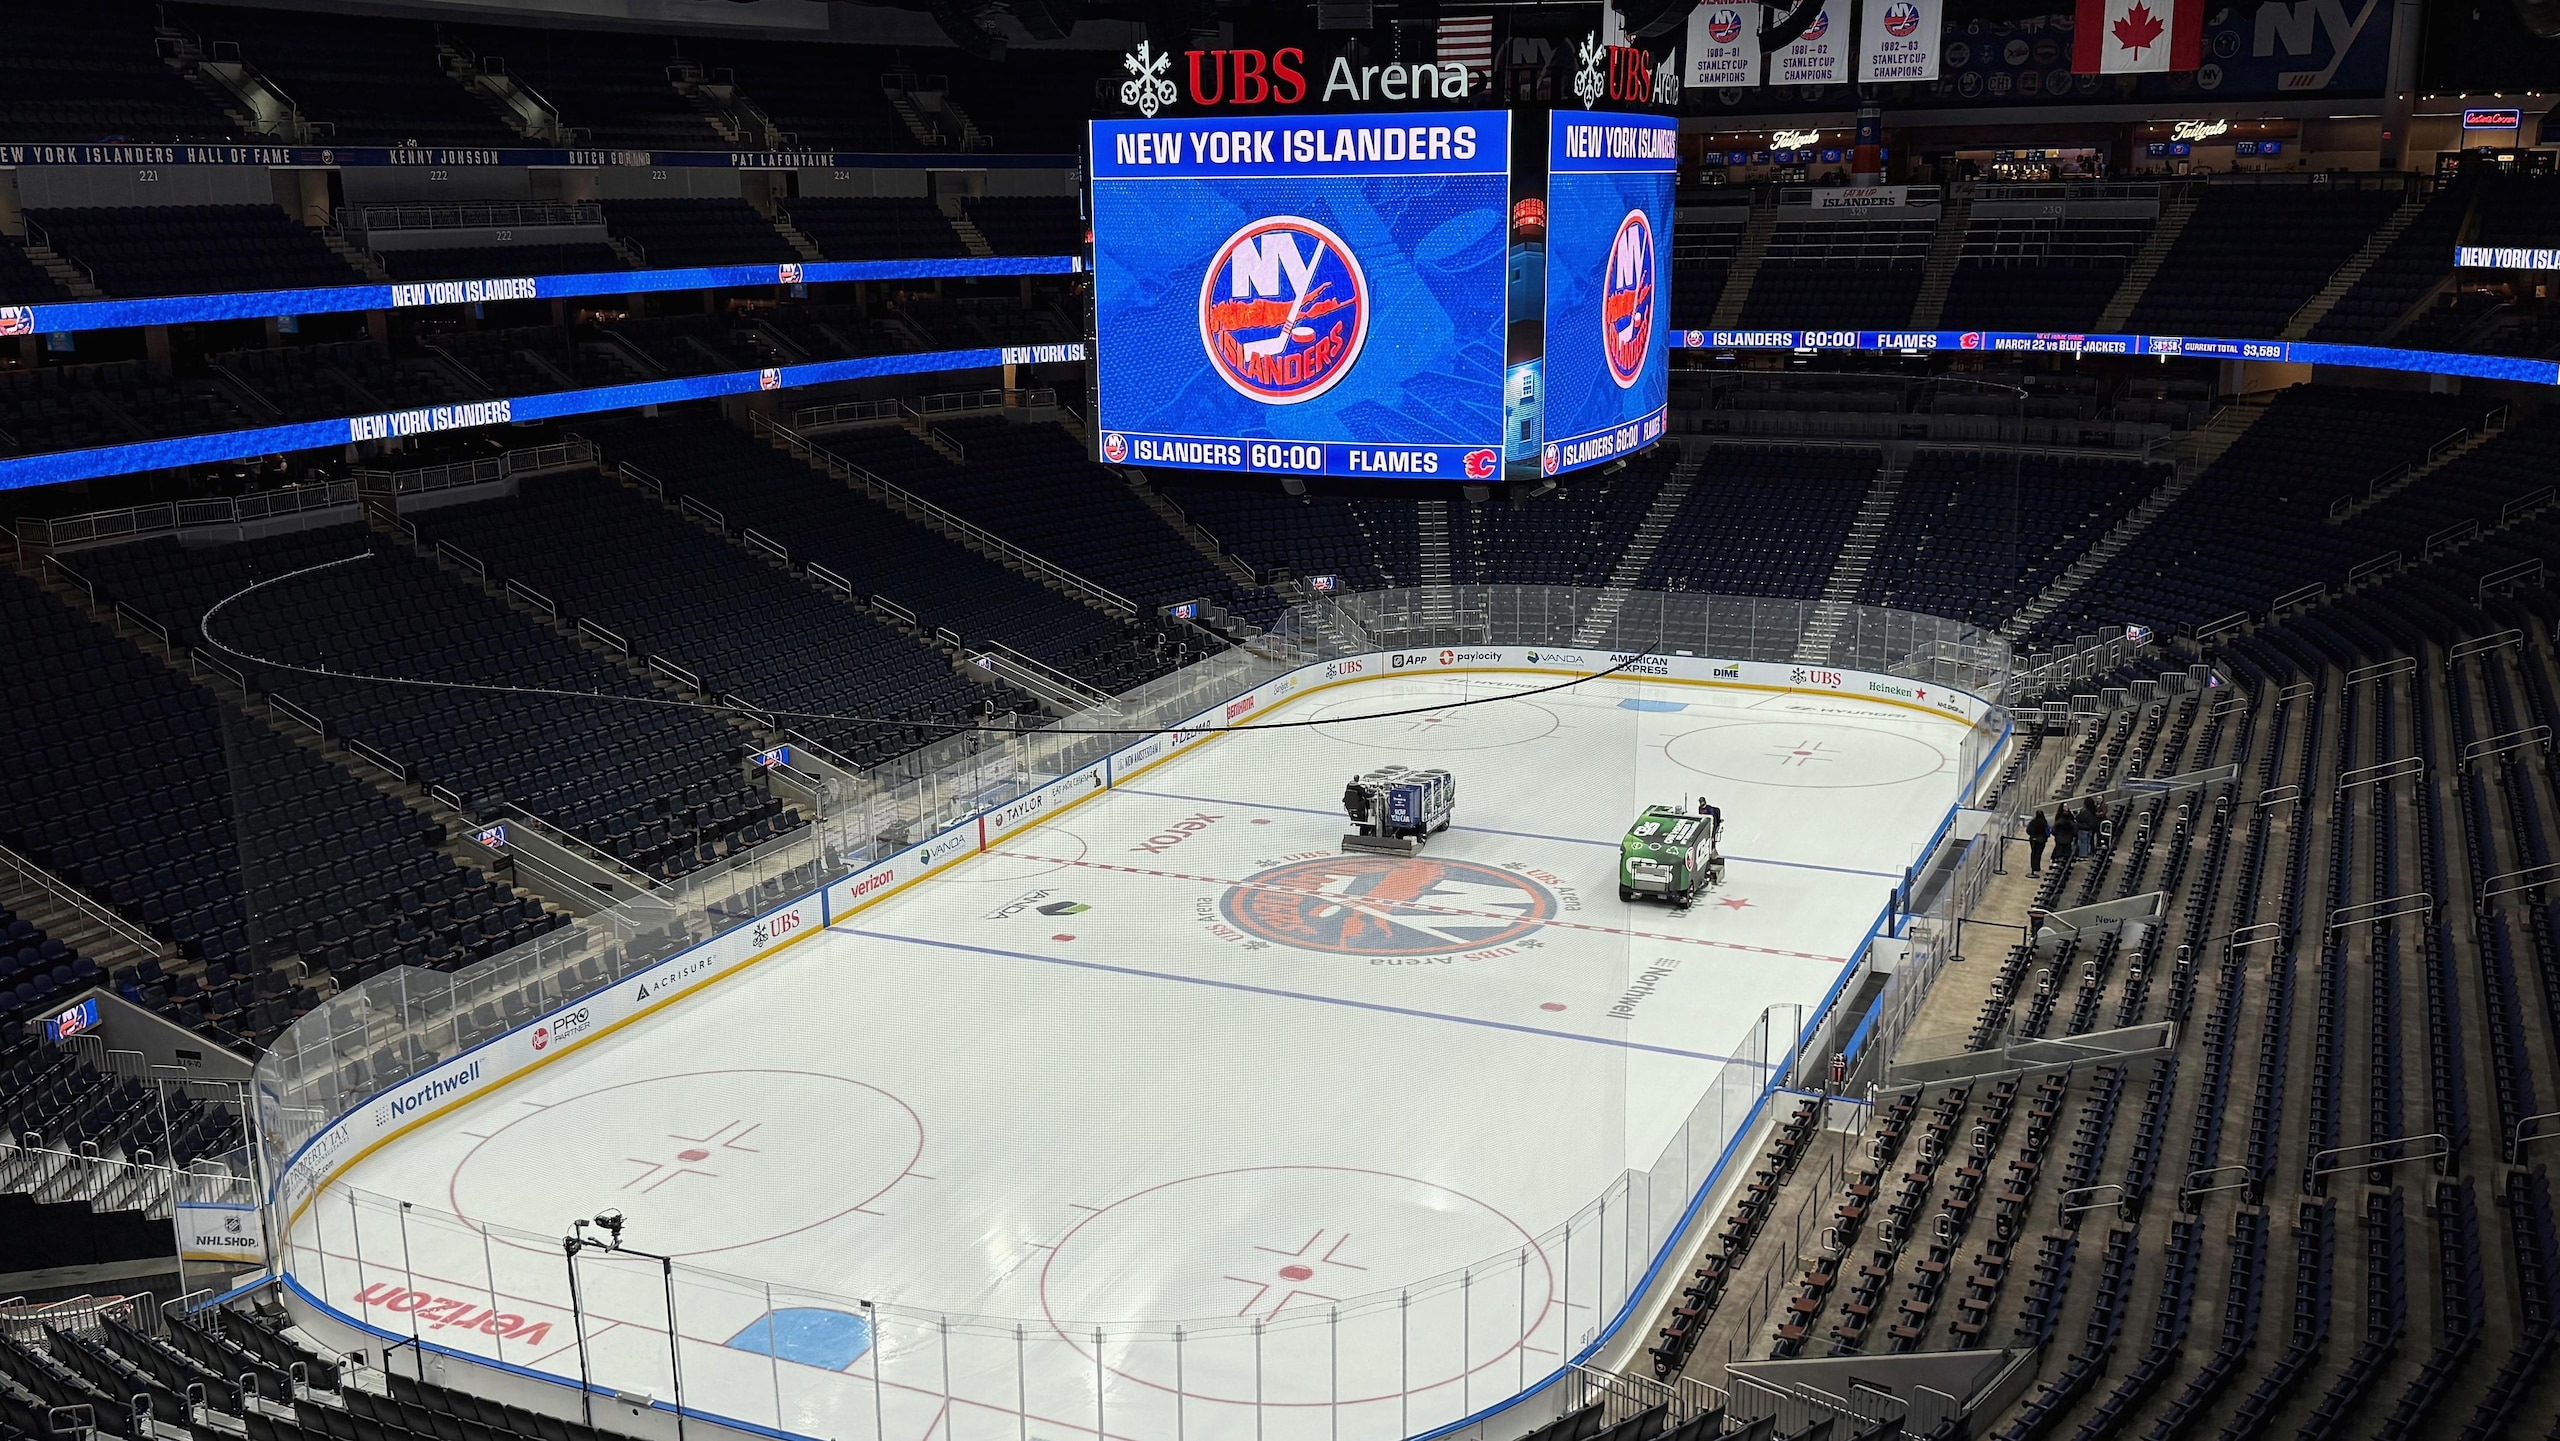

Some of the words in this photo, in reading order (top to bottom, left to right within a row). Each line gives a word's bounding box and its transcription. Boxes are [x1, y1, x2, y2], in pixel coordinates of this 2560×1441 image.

[1697, 60, 1731, 70] STANLEY
[1732, 60, 1748, 70] CUP
[1783, 57, 1817, 68] STANLEY
[1818, 57, 1835, 68] CUP
[1872, 54, 1907, 65] STANLEY
[1908, 53, 1926, 64] CUP
[1185, 48, 1307, 105] UBS
[1322, 57, 1470, 102] Arena
[1608, 45, 1651, 103] UBS
[1652, 63, 1679, 105] Arena
[1699, 72, 1745, 83] CHAMPIONS
[1784, 70, 1832, 80] CHAMPIONS
[1874, 66, 1923, 77] CHAMPIONS
[2170, 118, 2229, 142] Tailgate
[1116, 131, 1183, 165] NEW
[1191, 130, 1275, 163] YORK
[1283, 126, 1477, 162] ISLANDERS
[1566, 125, 1603, 158] NEW
[1605, 126, 1637, 158] YORK
[1638, 127, 1676, 159] ISLANDERS
[1770, 129, 1819, 150] Tailgate
[0, 147, 24, 163] EW
[35, 147, 77, 163] YORK
[86, 147, 174, 163] ISLANDERS
[188, 147, 224, 163] HALL
[231, 147, 247, 163] OF
[254, 148, 291, 163] FAME
[390, 150, 434, 165] KENNY
[441, 150, 499, 165] JONSSON
[569, 150, 605, 165] BUTCH
[732, 153, 754, 167] PAT
[761, 153, 835, 168] LAFONTAINE
[139, 171, 158, 182] 221
[430, 171, 448, 181] 222
[652, 171, 667, 180] 223
[834, 171, 850, 181] 224
[2312, 174, 2328, 184] 231
[1822, 197, 1895, 208] ISLANDERS
[496, 231, 512, 241] 222
[2461, 248, 2493, 266] NEW
[2494, 249, 2531, 268] YORK
[393, 285, 424, 306] NEW
[425, 283, 463, 304] YORK
[465, 278, 536, 302] ISLANDERS
[1713, 333, 1792, 346] ISLANDERS
[1805, 331, 1855, 347] 60:00
[1877, 334, 1937, 348] FLAMES
[1995, 338, 2030, 351] MARCH
[2032, 340, 2045, 351] 22
[2046, 342, 2057, 351] vs
[2059, 340, 2081, 351] BLUE
[2083, 341, 2126, 353] JACKETS
[1002, 347, 1029, 364] NEW
[1030, 345, 1067, 363] YORK
[1217, 321, 1345, 385] ISLANDERS
[2184, 343, 2214, 352] CURRENT
[2216, 344, 2238, 354] TOTAL
[350, 415, 387, 441] NEW
[388, 410, 431, 437] YORK
[432, 400, 511, 432] ISLANDERS
[1616, 424, 1639, 453] 60:00
[1134, 441, 1241, 465] ISLANDERS
[1252, 446, 1320, 470] 60:00
[1563, 434, 1614, 467] ISLANDERS
[1349, 450, 1438, 473] FLAMES
[1457, 651, 1502, 663] paylocity
[1540, 653, 1585, 664] VANDA
[1610, 654, 1668, 666] AMERICAN
[1339, 660, 1363, 675] UBS
[1618, 664, 1668, 675] EXPRESS
[1713, 668, 1739, 678] DIME
[1810, 670, 1842, 686] UBS
[1869, 681, 1912, 698] Heineken
[1007, 795, 1042, 820] TAYLOR
[1131, 812, 1224, 854] xerox
[930, 832, 966, 858] VANDA
[851, 868, 894, 898] verizon
[1526, 869, 1566, 886] UBS
[770, 910, 800, 938] UBS
[1462, 947, 1519, 962] UBS
[653, 955, 713, 991] ACRISURE
[1607, 964, 1673, 1020] Northwell
[553, 1007, 589, 1035] PRO
[554, 1021, 590, 1043] PARTNER
[390, 1060, 480, 1120] Northwell
[329, 1123, 348, 1145] TAX
[354, 1282, 554, 1346] verizon
